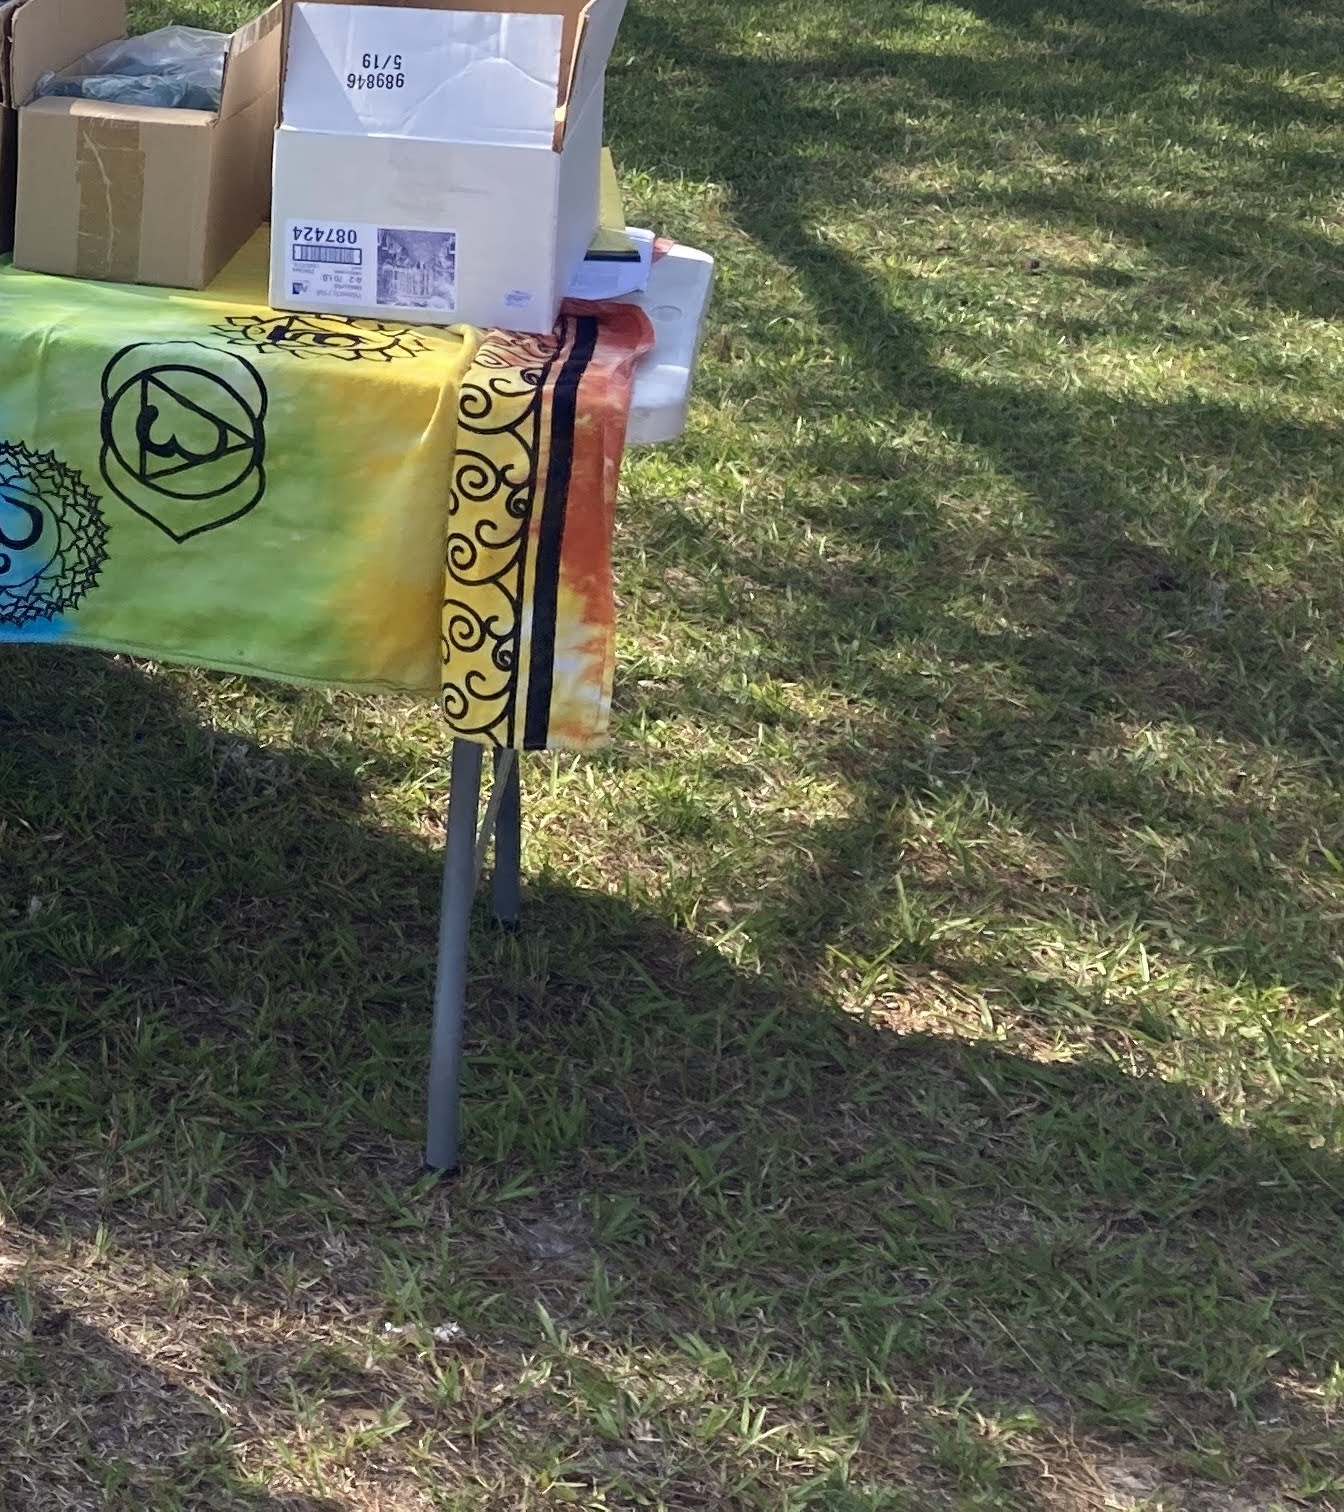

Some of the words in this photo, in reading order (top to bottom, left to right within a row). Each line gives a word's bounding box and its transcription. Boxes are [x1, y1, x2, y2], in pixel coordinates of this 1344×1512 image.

[362, 53, 403, 70] 5/19
[346, 72, 405, 90] 989846
[293, 225, 358, 245] 087424
